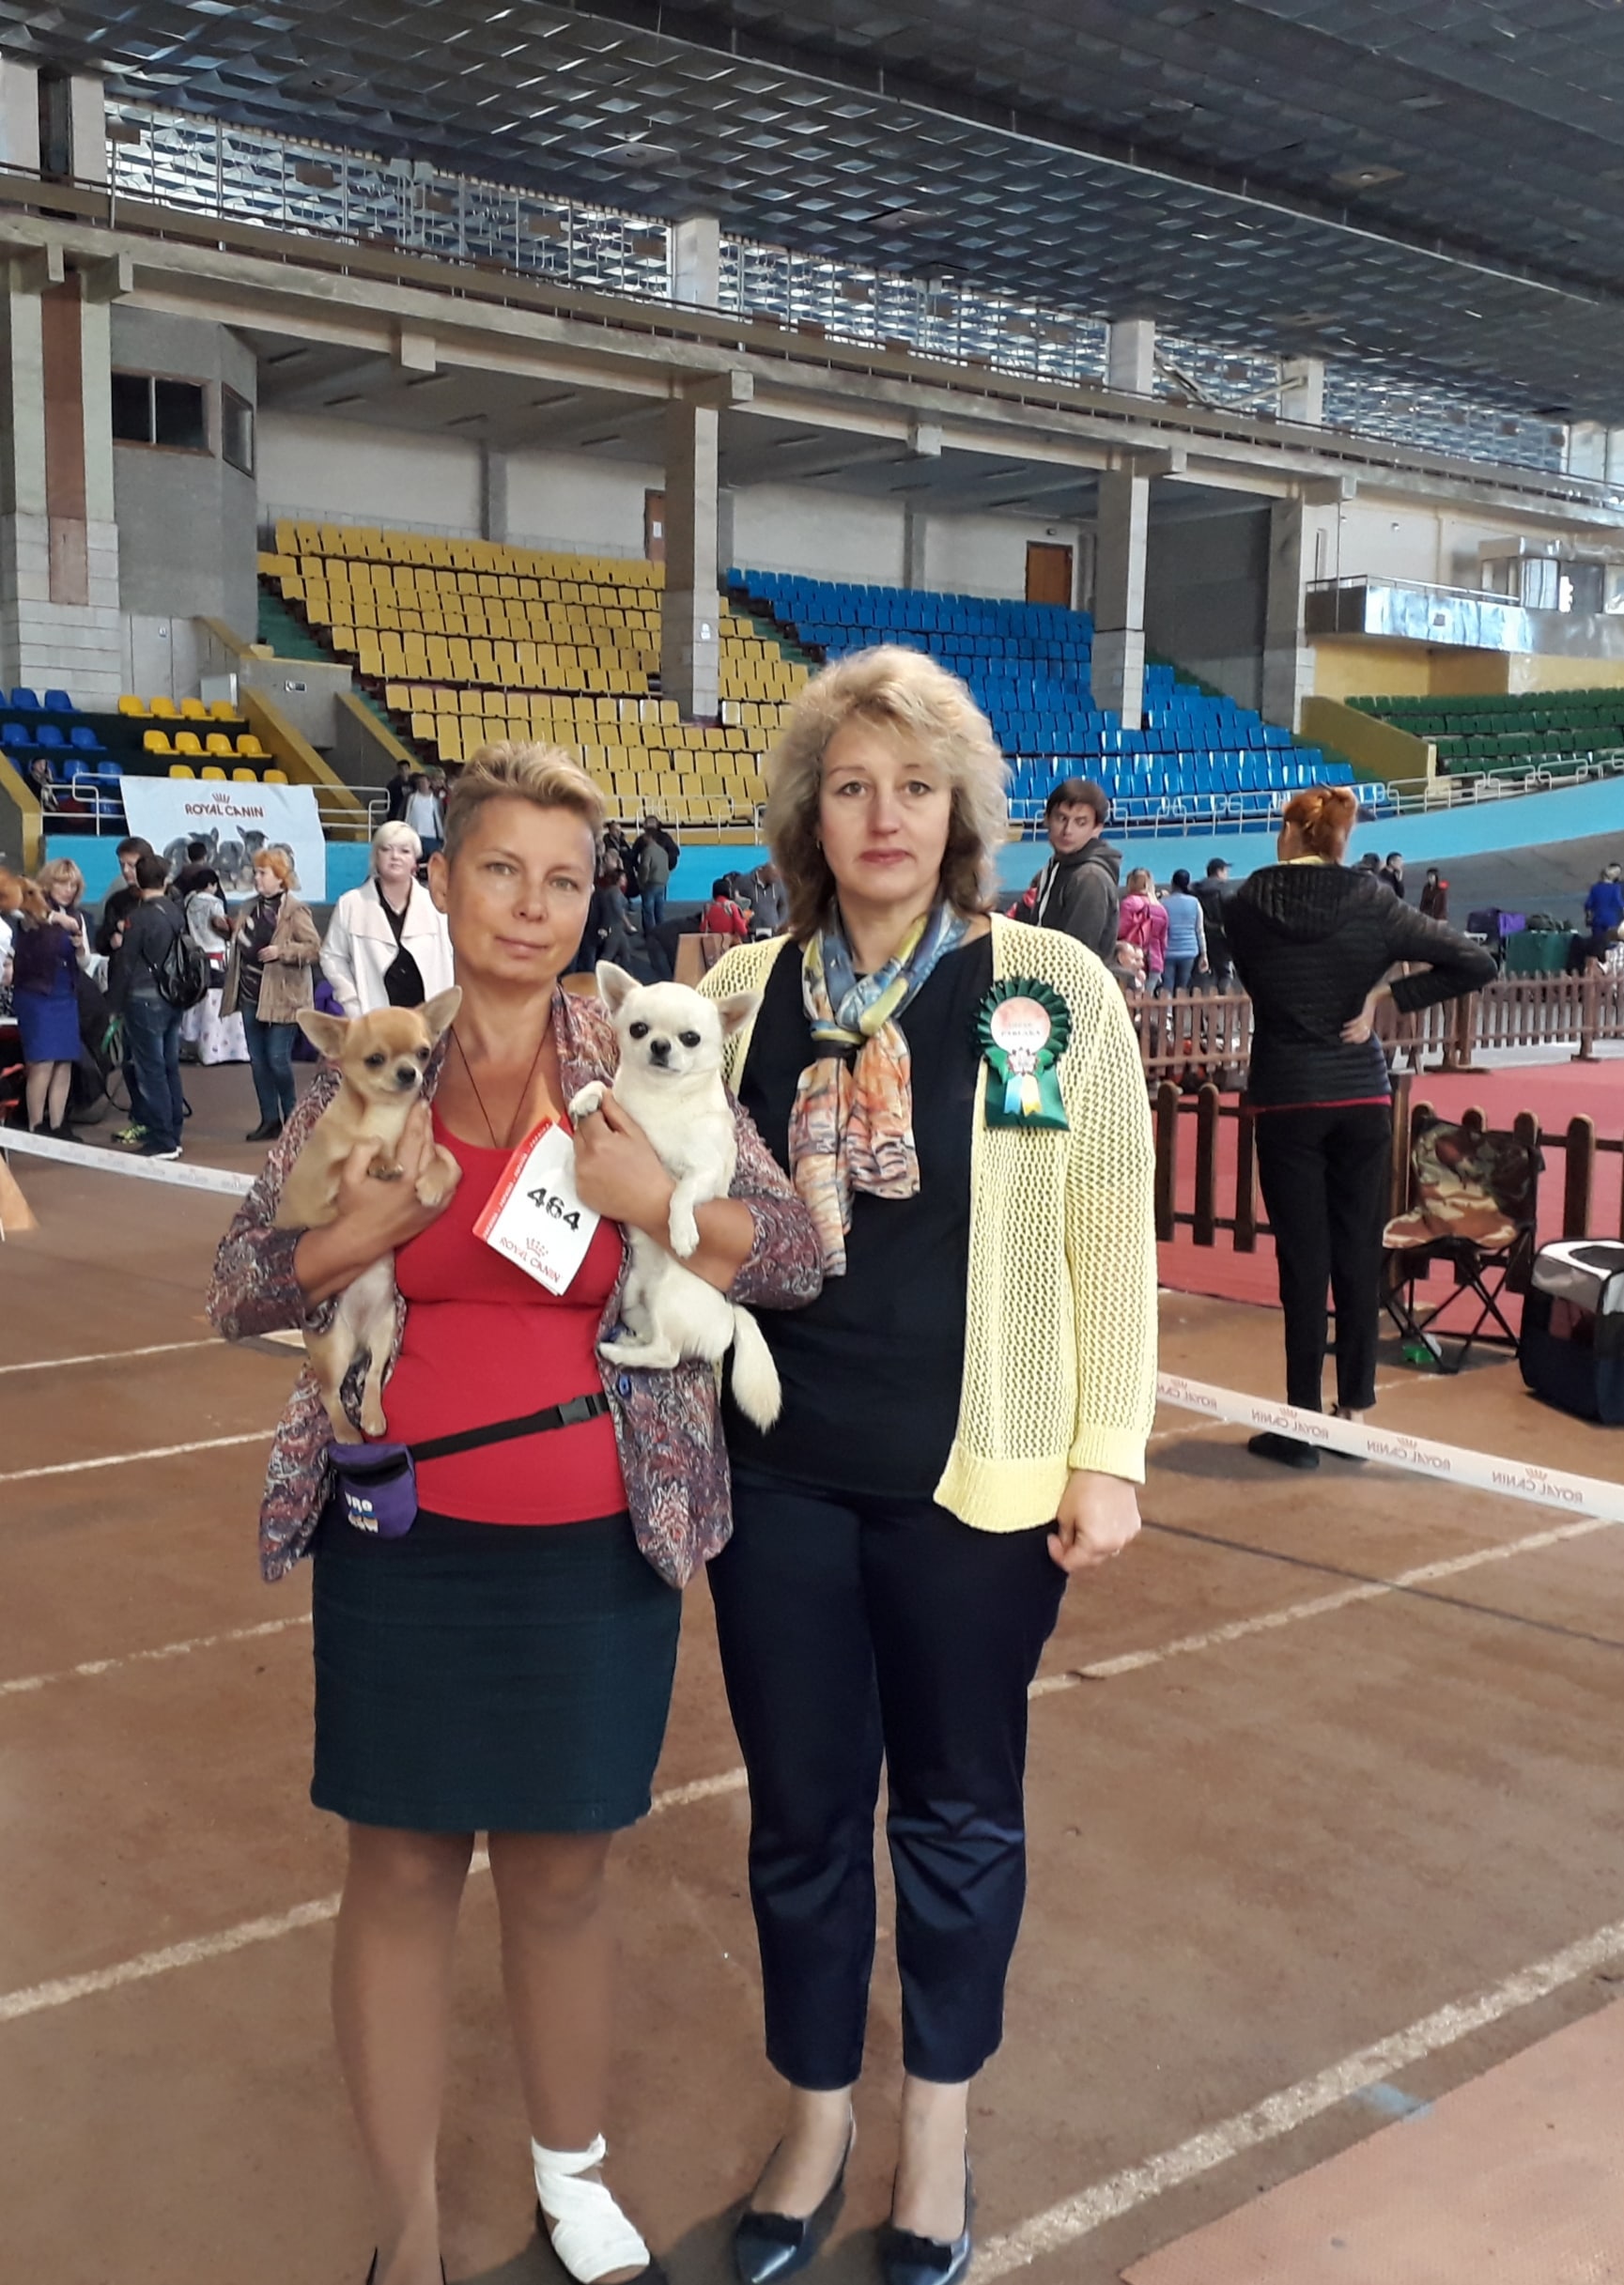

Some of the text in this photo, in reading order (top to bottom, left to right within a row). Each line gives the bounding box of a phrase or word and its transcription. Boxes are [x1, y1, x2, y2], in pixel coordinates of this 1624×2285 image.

[184, 803, 264, 818] ROYAL CANIN
[527, 1187, 581, 1232] 464
[499, 1236, 562, 1284] ROYAL CANIN
